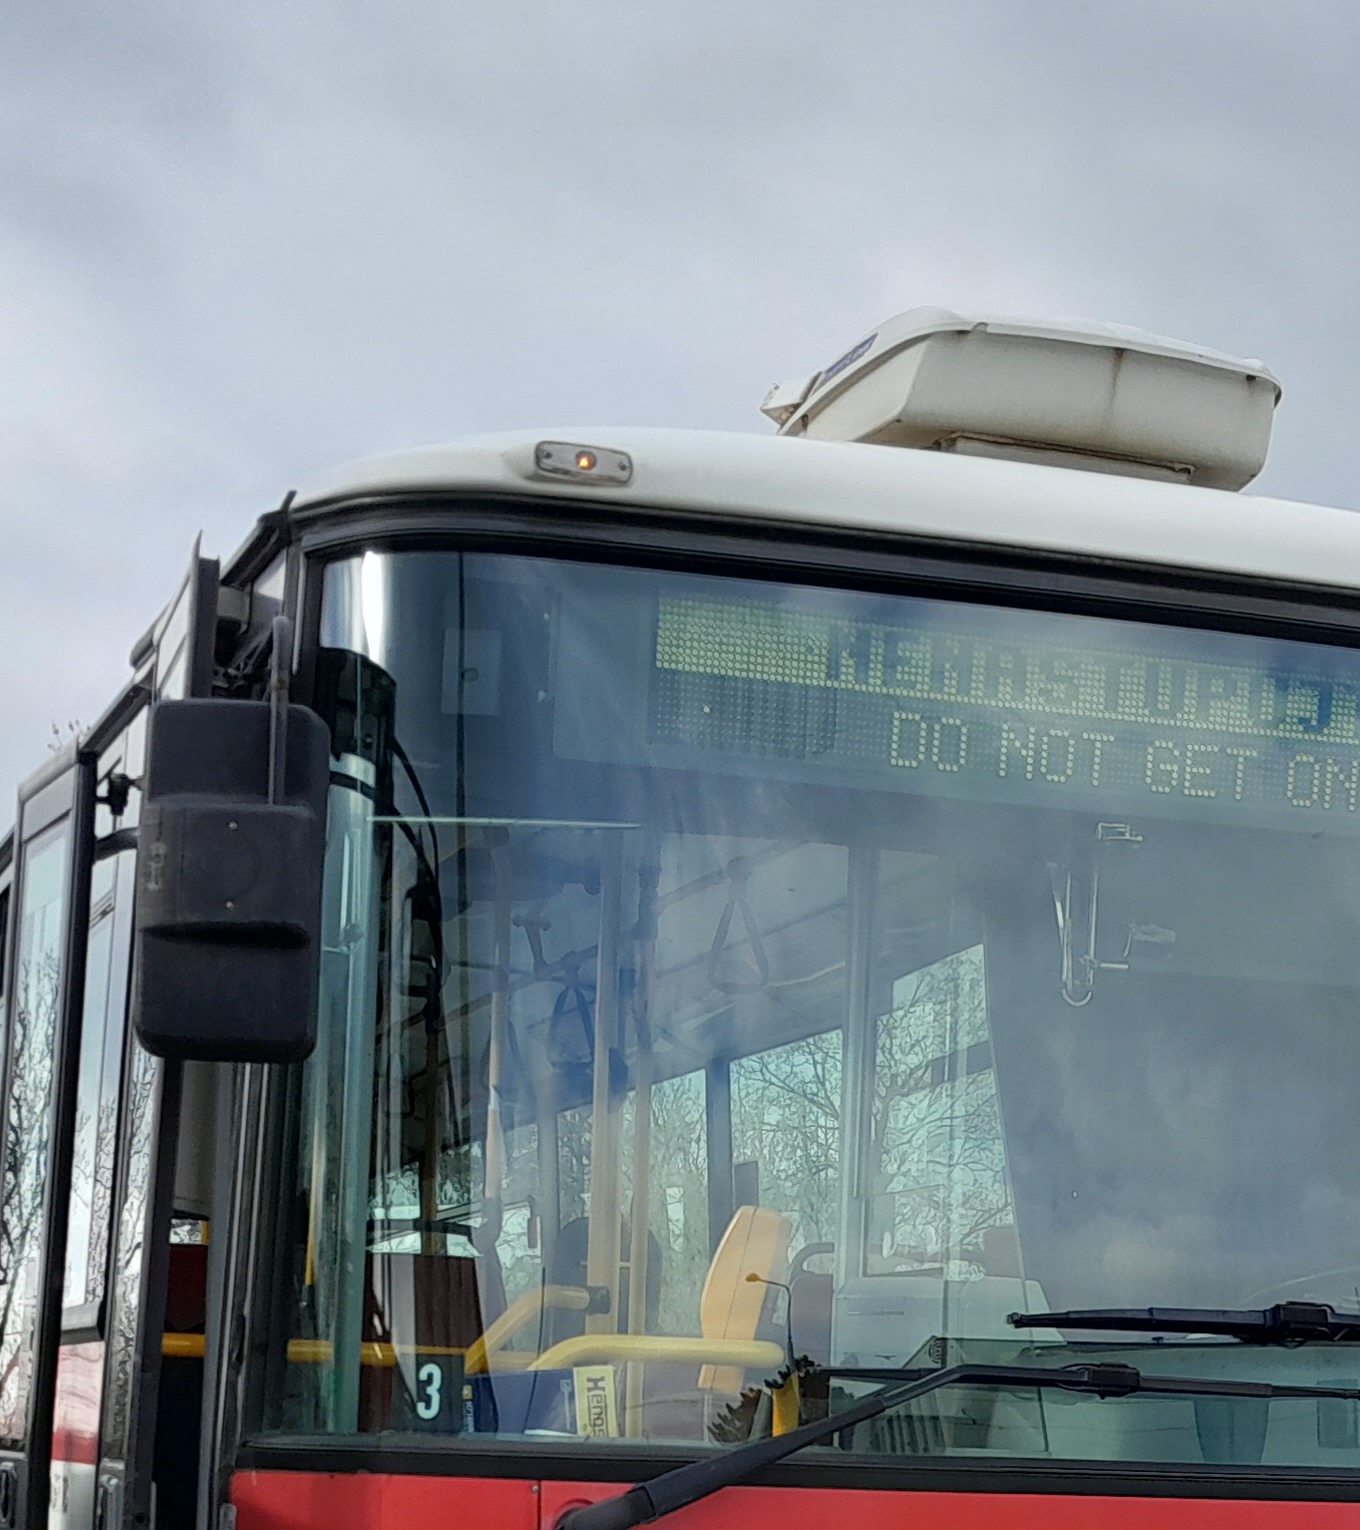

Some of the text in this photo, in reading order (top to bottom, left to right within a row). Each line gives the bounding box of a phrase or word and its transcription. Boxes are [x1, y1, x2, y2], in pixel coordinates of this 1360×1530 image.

[890, 711, 1360, 812] DO NOT GET ON
[417, 1363, 442, 1420] 3
